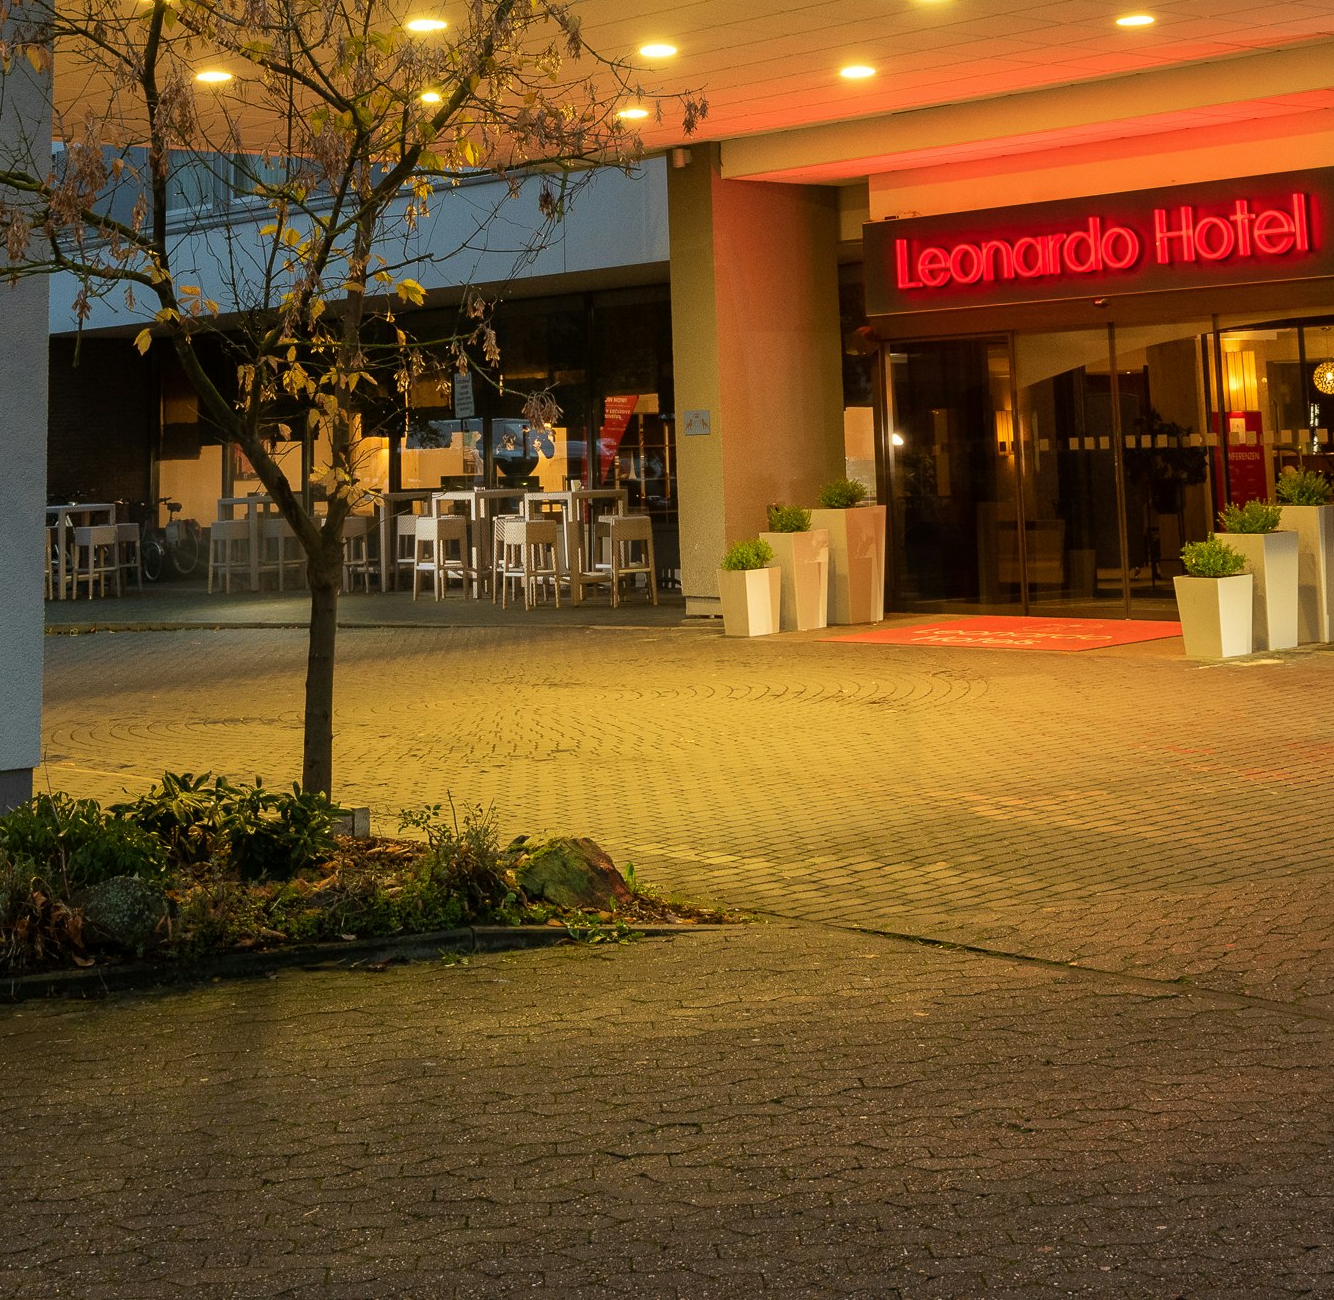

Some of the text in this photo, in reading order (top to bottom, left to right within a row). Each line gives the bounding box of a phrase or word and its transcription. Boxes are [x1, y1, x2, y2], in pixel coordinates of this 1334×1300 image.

[895, 192, 1311, 290] Leonardo Hotel
[1228, 451, 1260, 461] NFERENZEN
